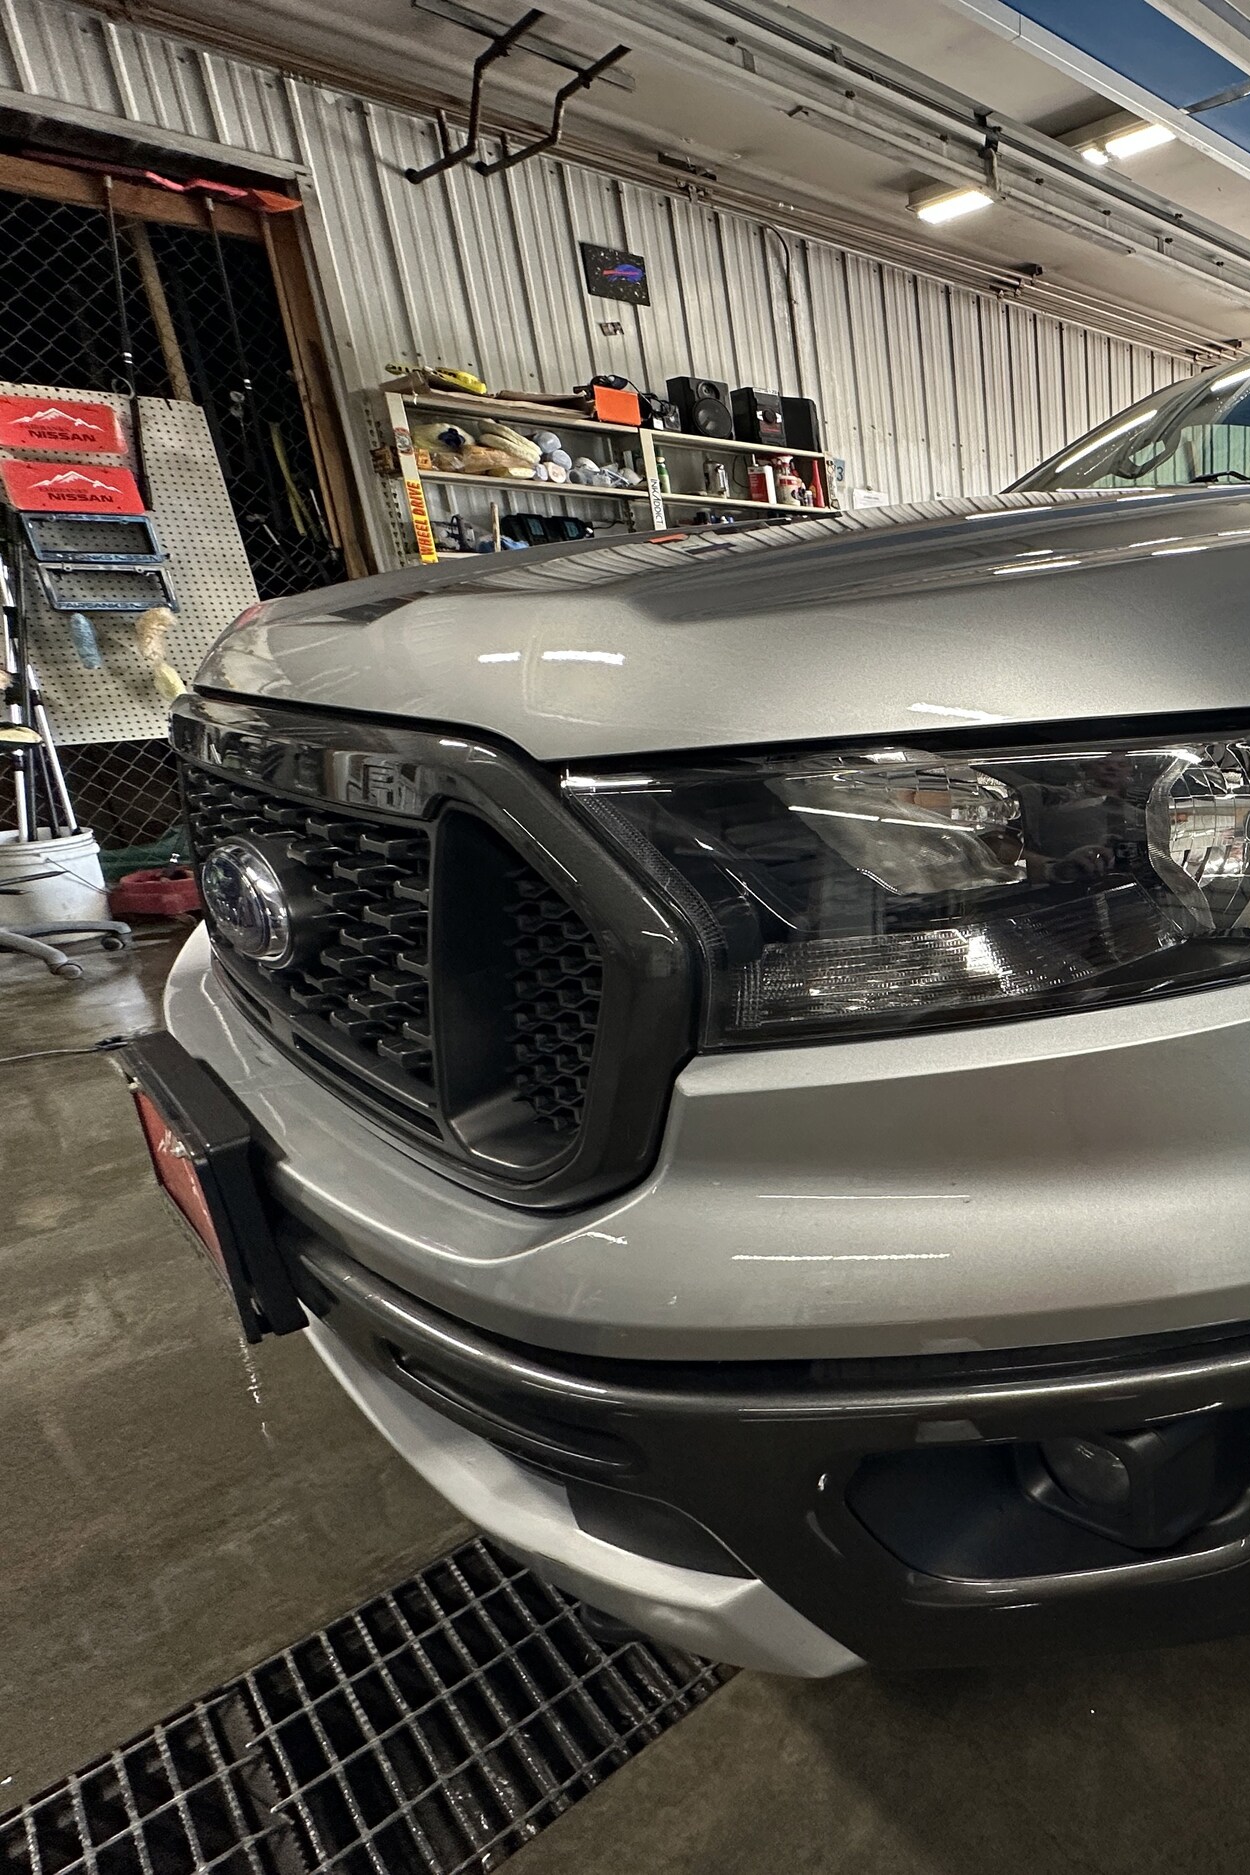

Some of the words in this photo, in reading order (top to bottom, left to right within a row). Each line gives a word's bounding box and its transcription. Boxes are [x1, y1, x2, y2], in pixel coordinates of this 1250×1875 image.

[28, 430, 97, 442] NISSAN
[836, 466, 844, 482] 3
[48, 492, 114, 503] NISSAN
[406, 481, 427, 517] DRIVE
[413, 519, 435, 556] WHEEL
